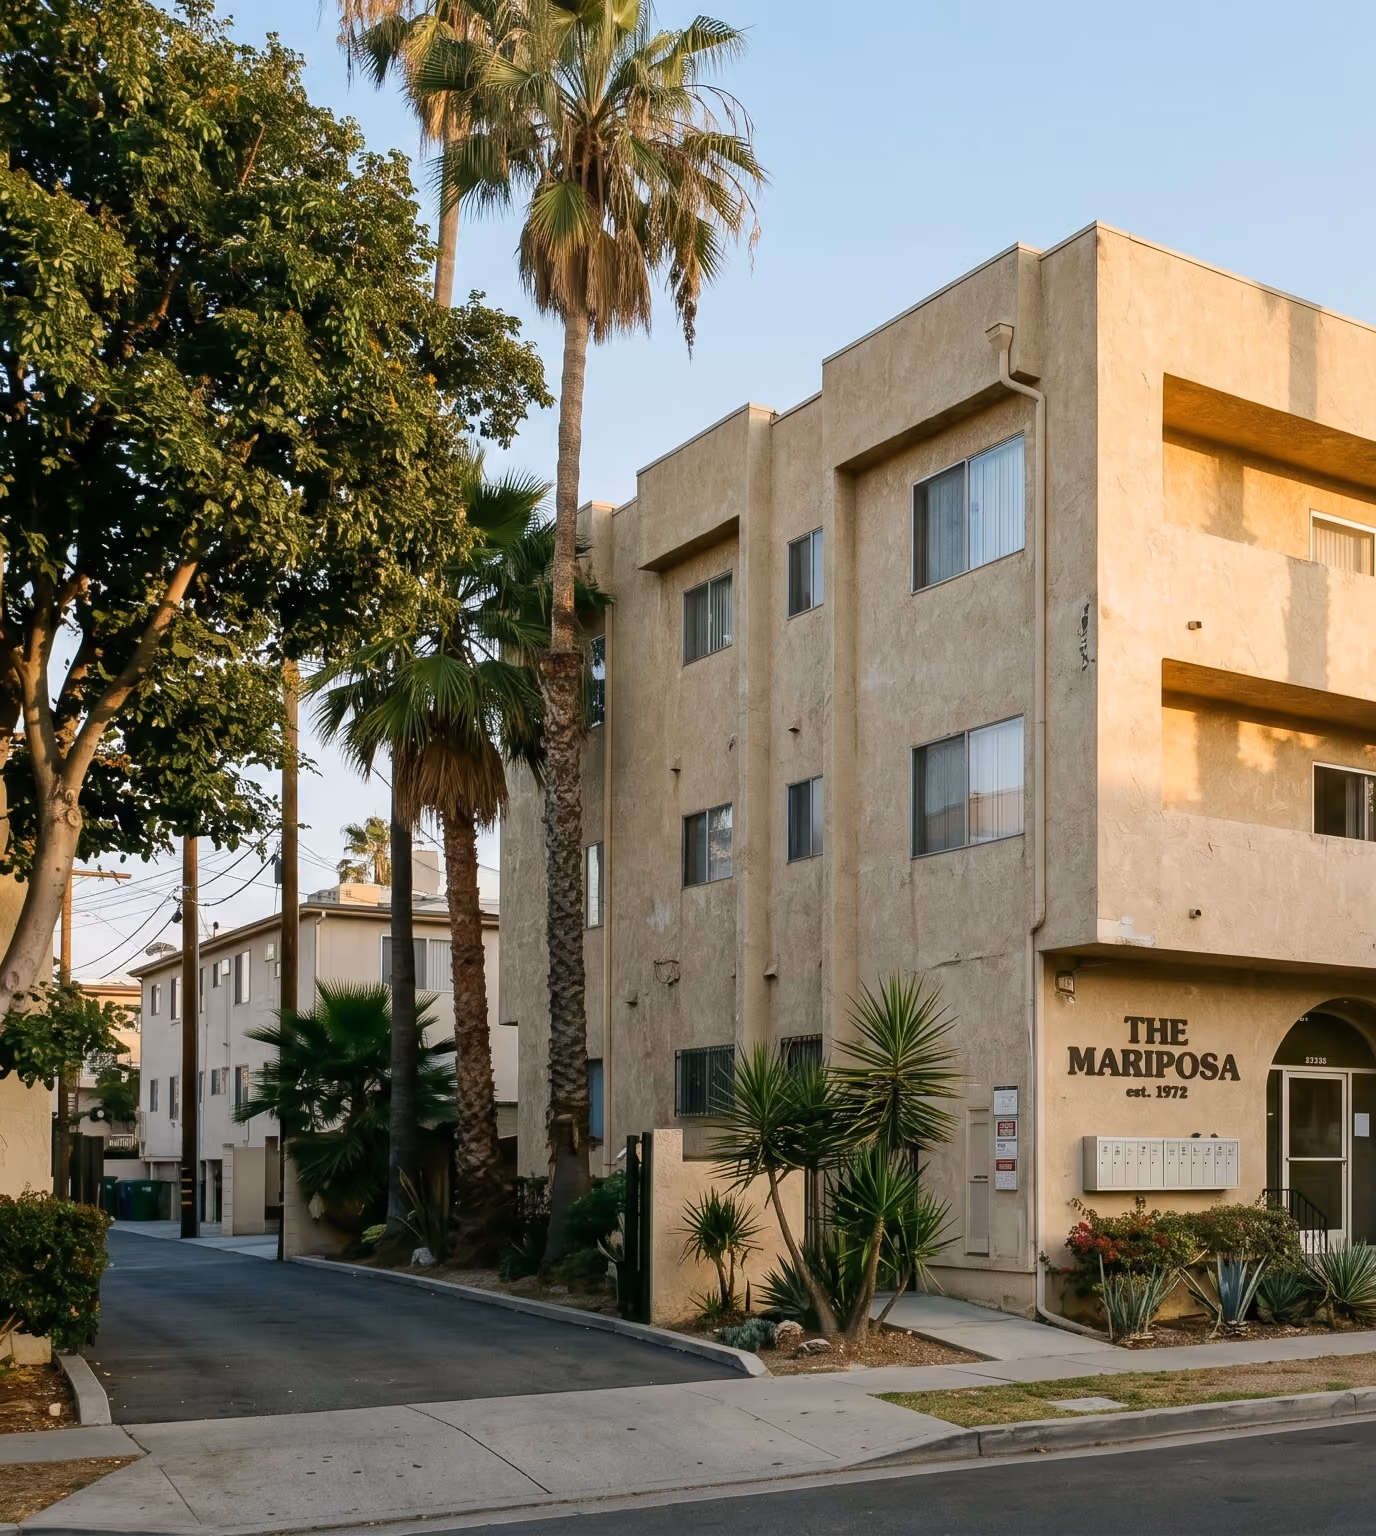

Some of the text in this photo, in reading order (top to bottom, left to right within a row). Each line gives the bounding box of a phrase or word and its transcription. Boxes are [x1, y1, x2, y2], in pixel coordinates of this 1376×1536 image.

[1124, 1016, 1189, 1046] THE
[1068, 1046, 1241, 1081] MARIPOSA
[1126, 1085, 1188, 1099] est. 1972
